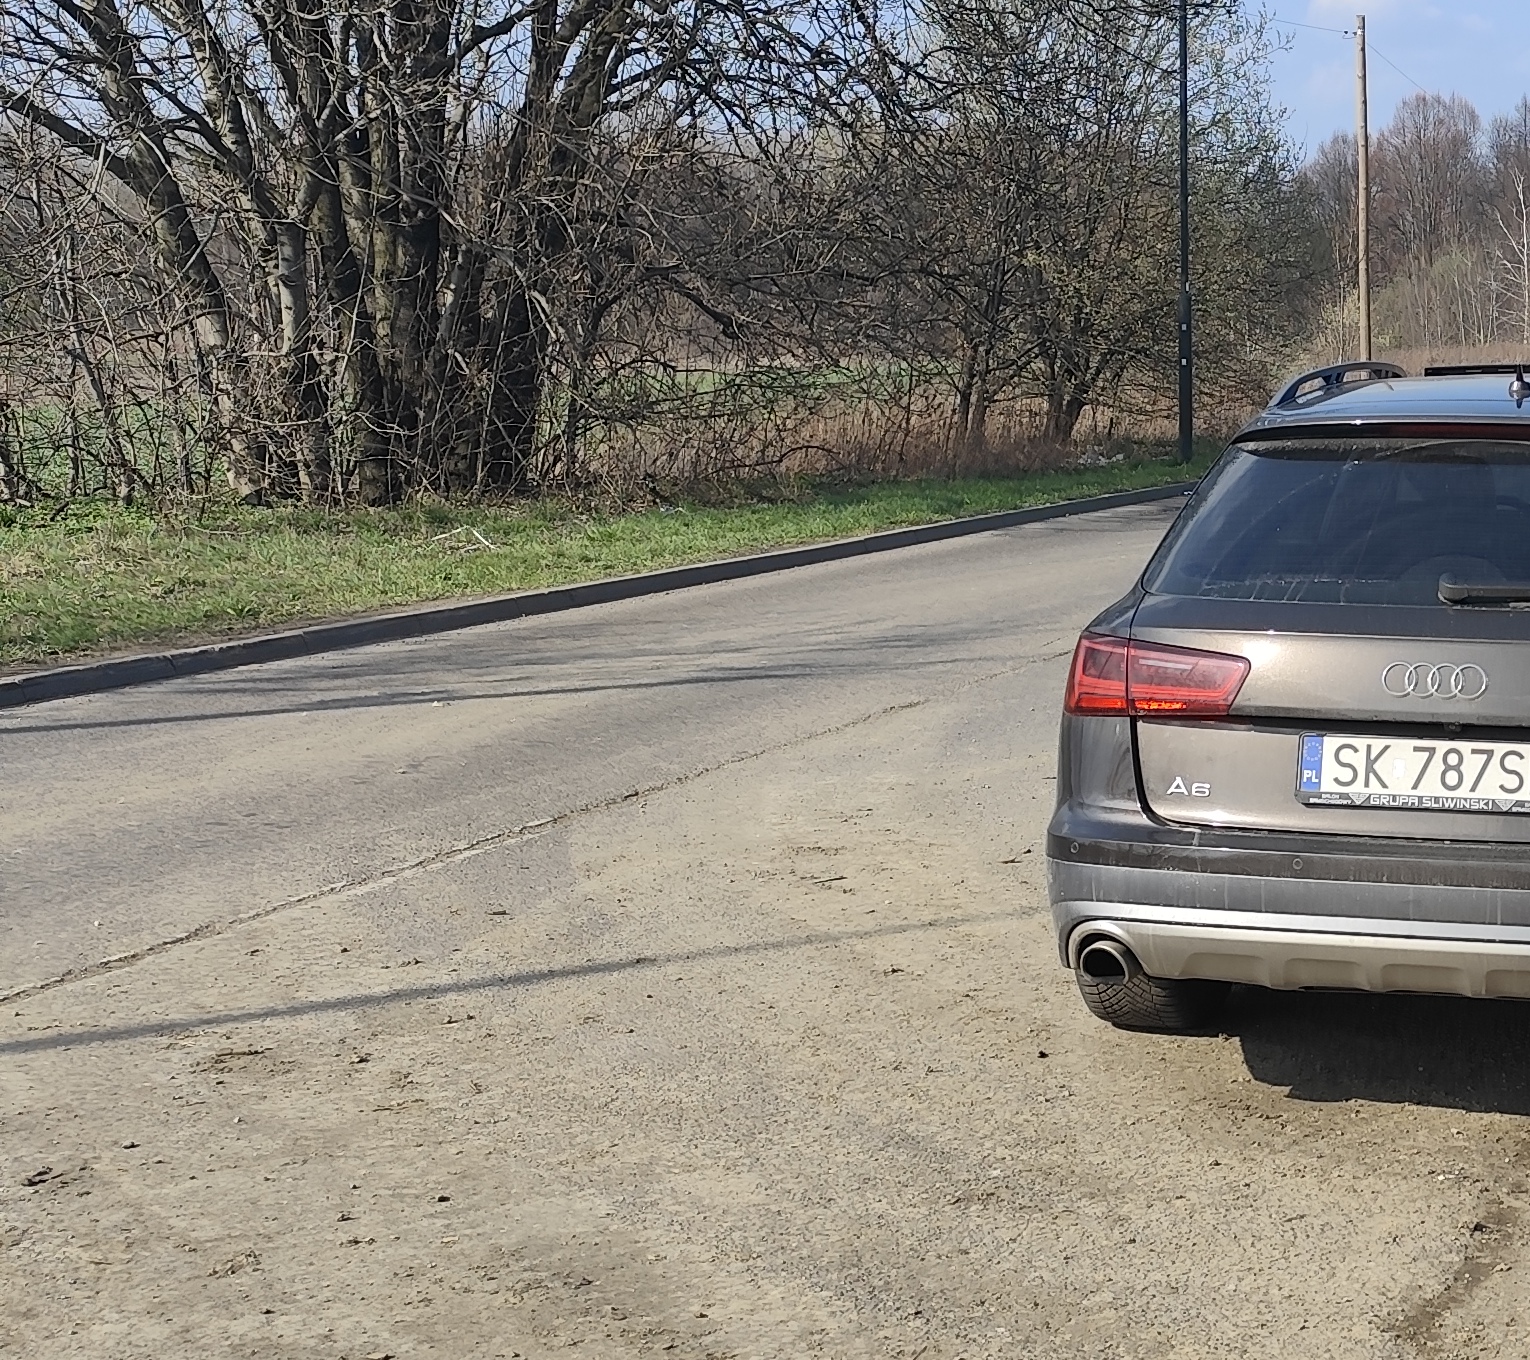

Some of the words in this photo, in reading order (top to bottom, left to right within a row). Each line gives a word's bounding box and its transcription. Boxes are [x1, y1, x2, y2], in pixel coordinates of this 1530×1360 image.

[1333, 743, 1391, 789] SK
[1303, 770, 1319, 782] PL
[1166, 776, 1210, 797] A6
[1370, 795, 1418, 807] GRUPA
[1422, 796, 1492, 810] SLIWINSKI
